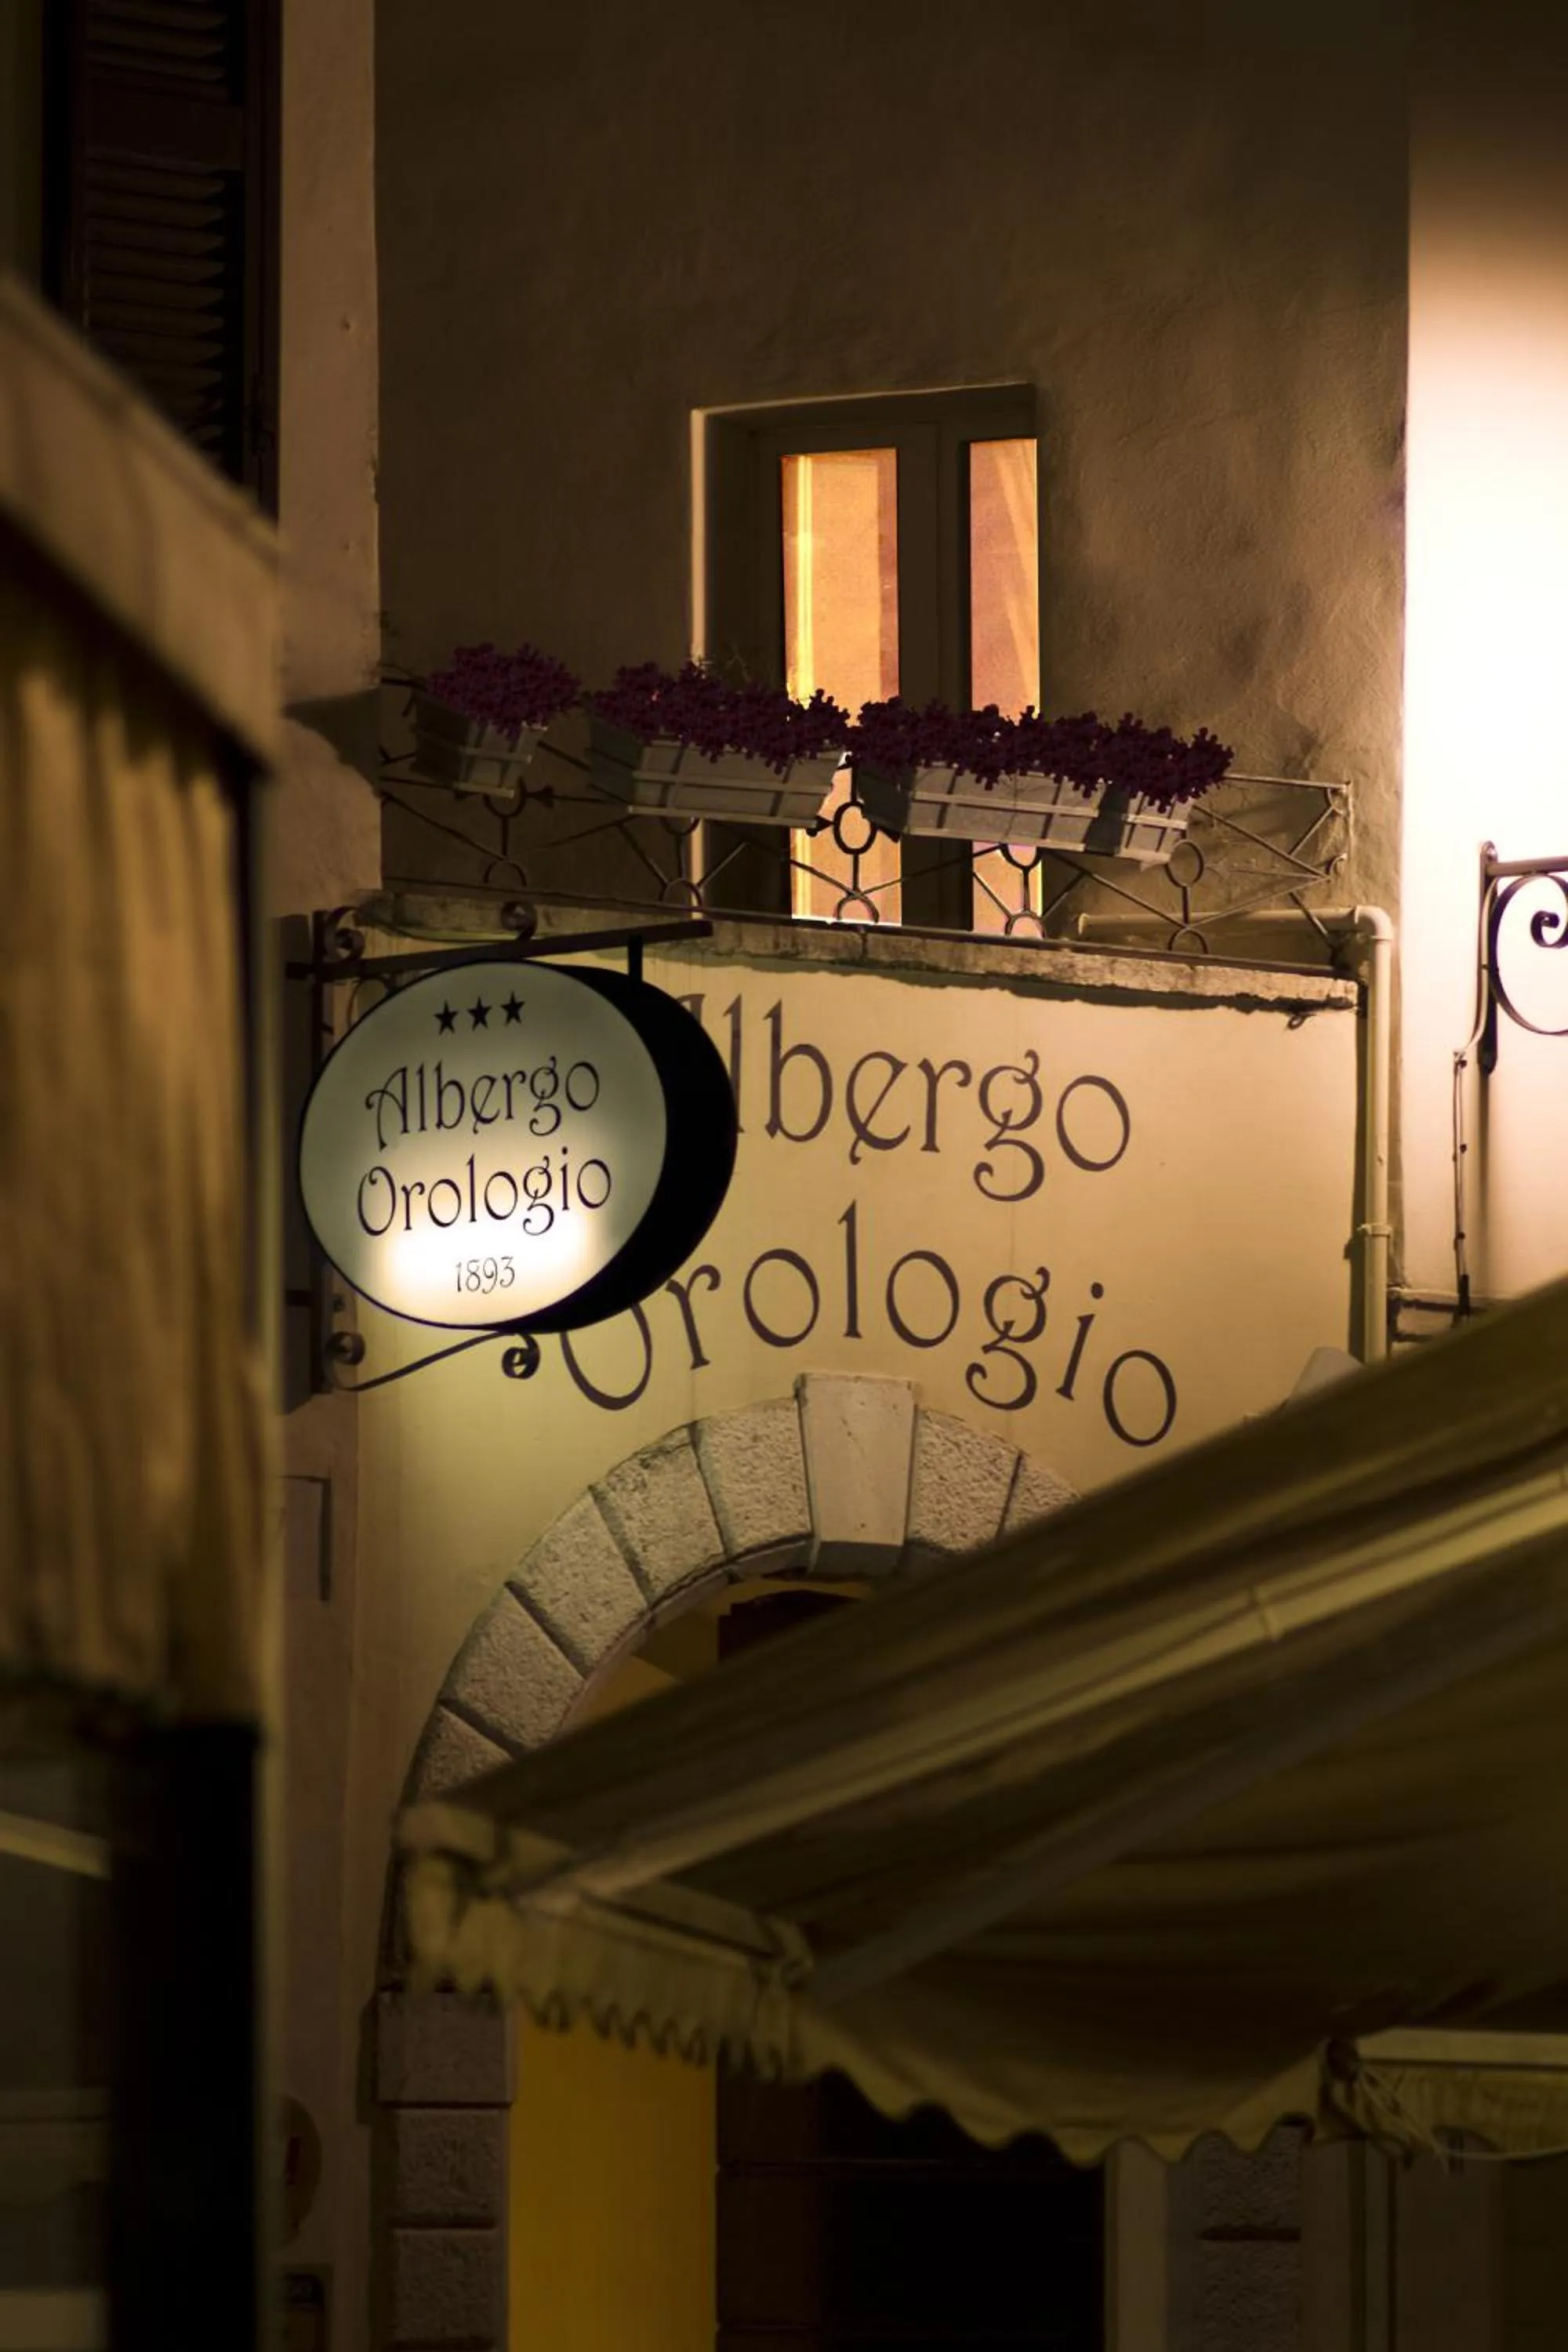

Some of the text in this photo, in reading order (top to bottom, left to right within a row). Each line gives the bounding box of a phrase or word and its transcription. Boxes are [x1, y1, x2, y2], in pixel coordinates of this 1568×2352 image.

[365, 1055, 599, 1152] Albergo
[677, 993, 1130, 1201] lbergo
[357, 1147, 612, 1236] Orologio
[456, 1256, 514, 1294] 1893
